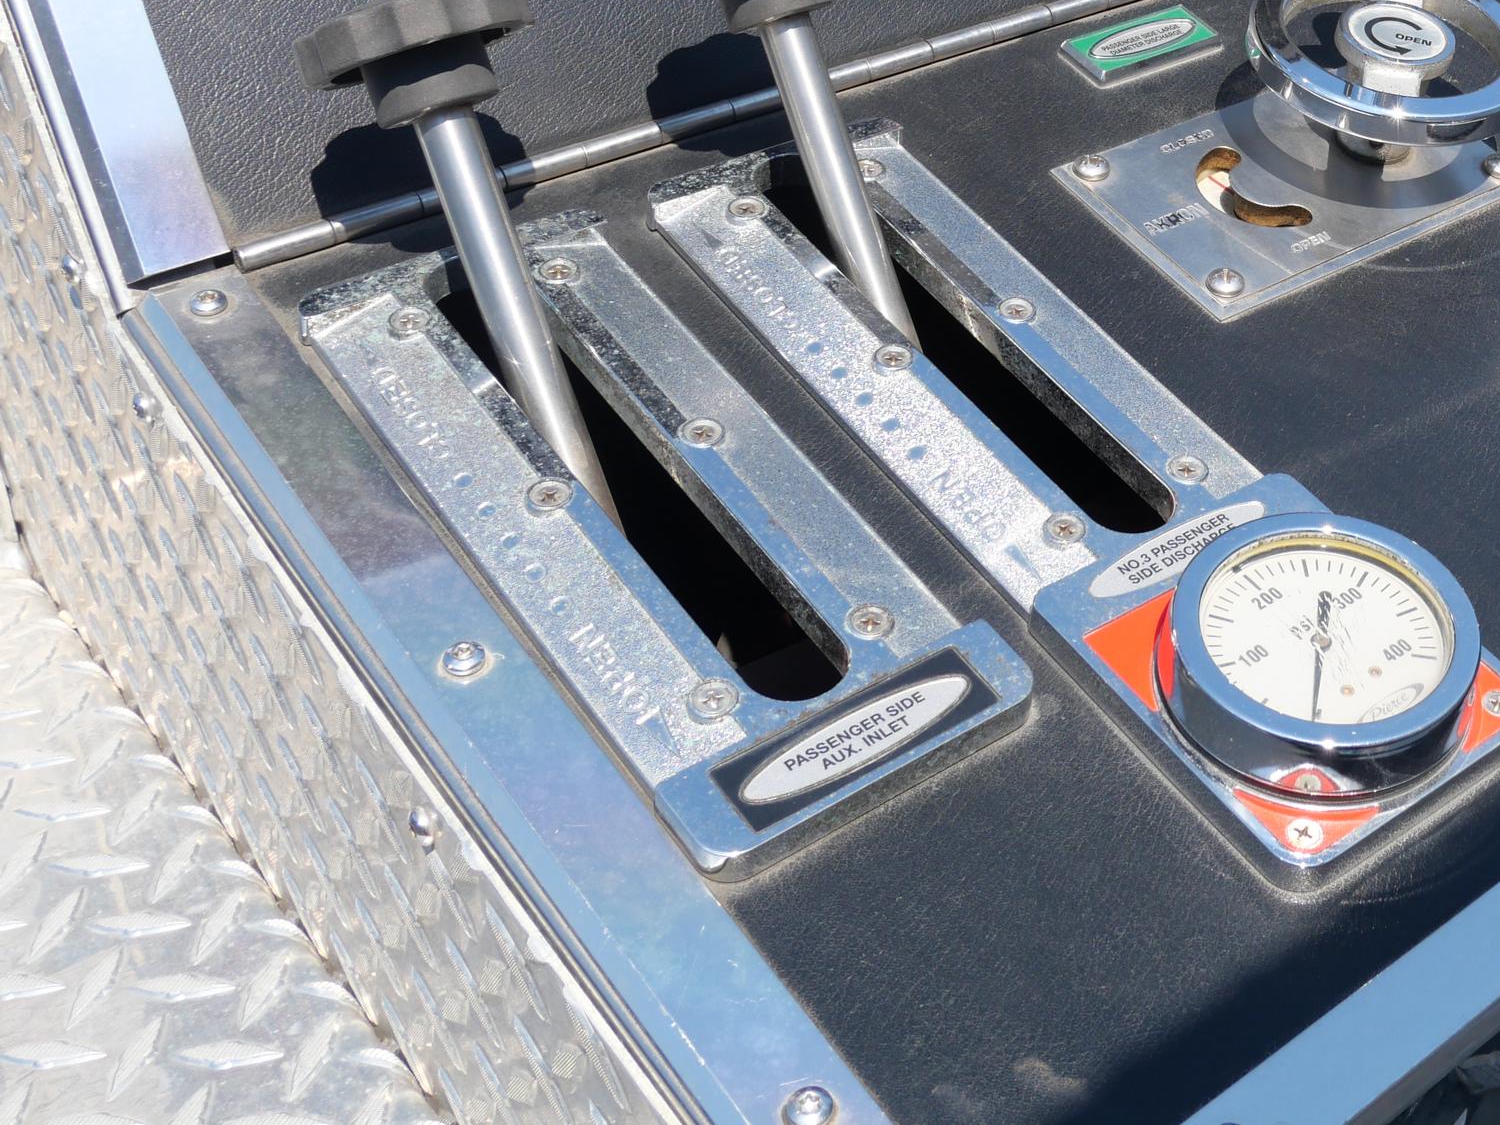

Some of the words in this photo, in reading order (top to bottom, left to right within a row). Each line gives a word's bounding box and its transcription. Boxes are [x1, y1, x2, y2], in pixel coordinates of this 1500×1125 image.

[1101, 35, 1140, 52] PASSENGER
[1140, 30, 1156, 42] SIDE
[1156, 23, 1181, 37] LARGE
[1110, 41, 1145, 55] DIAMETER
[1145, 29, 1183, 45] DISCHARGE
[1395, 33, 1432, 46] OPEN
[1143, 201, 1212, 236] AKRON
[1290, 231, 1332, 254] OPEN
[1117, 553, 1151, 576] NO.3
[1150, 513, 1230, 558] PASSENGER
[1128, 562, 1163, 585] SIDE
[1251, 587, 1283, 610] 200
[1332, 587, 1363, 610] 300
[1290, 615, 1315, 641] psi
[1238, 644, 1269, 668] 100
[1382, 638, 1412, 662] 400
[567, 622, 650, 715] OPEN
[1370, 691, 1408, 722] Pierce
[783, 713, 886, 771] PASSENGER
[886, 691, 926, 718] SIDE
[822, 744, 863, 770] AUX.
[863, 715, 910, 747] INLET
